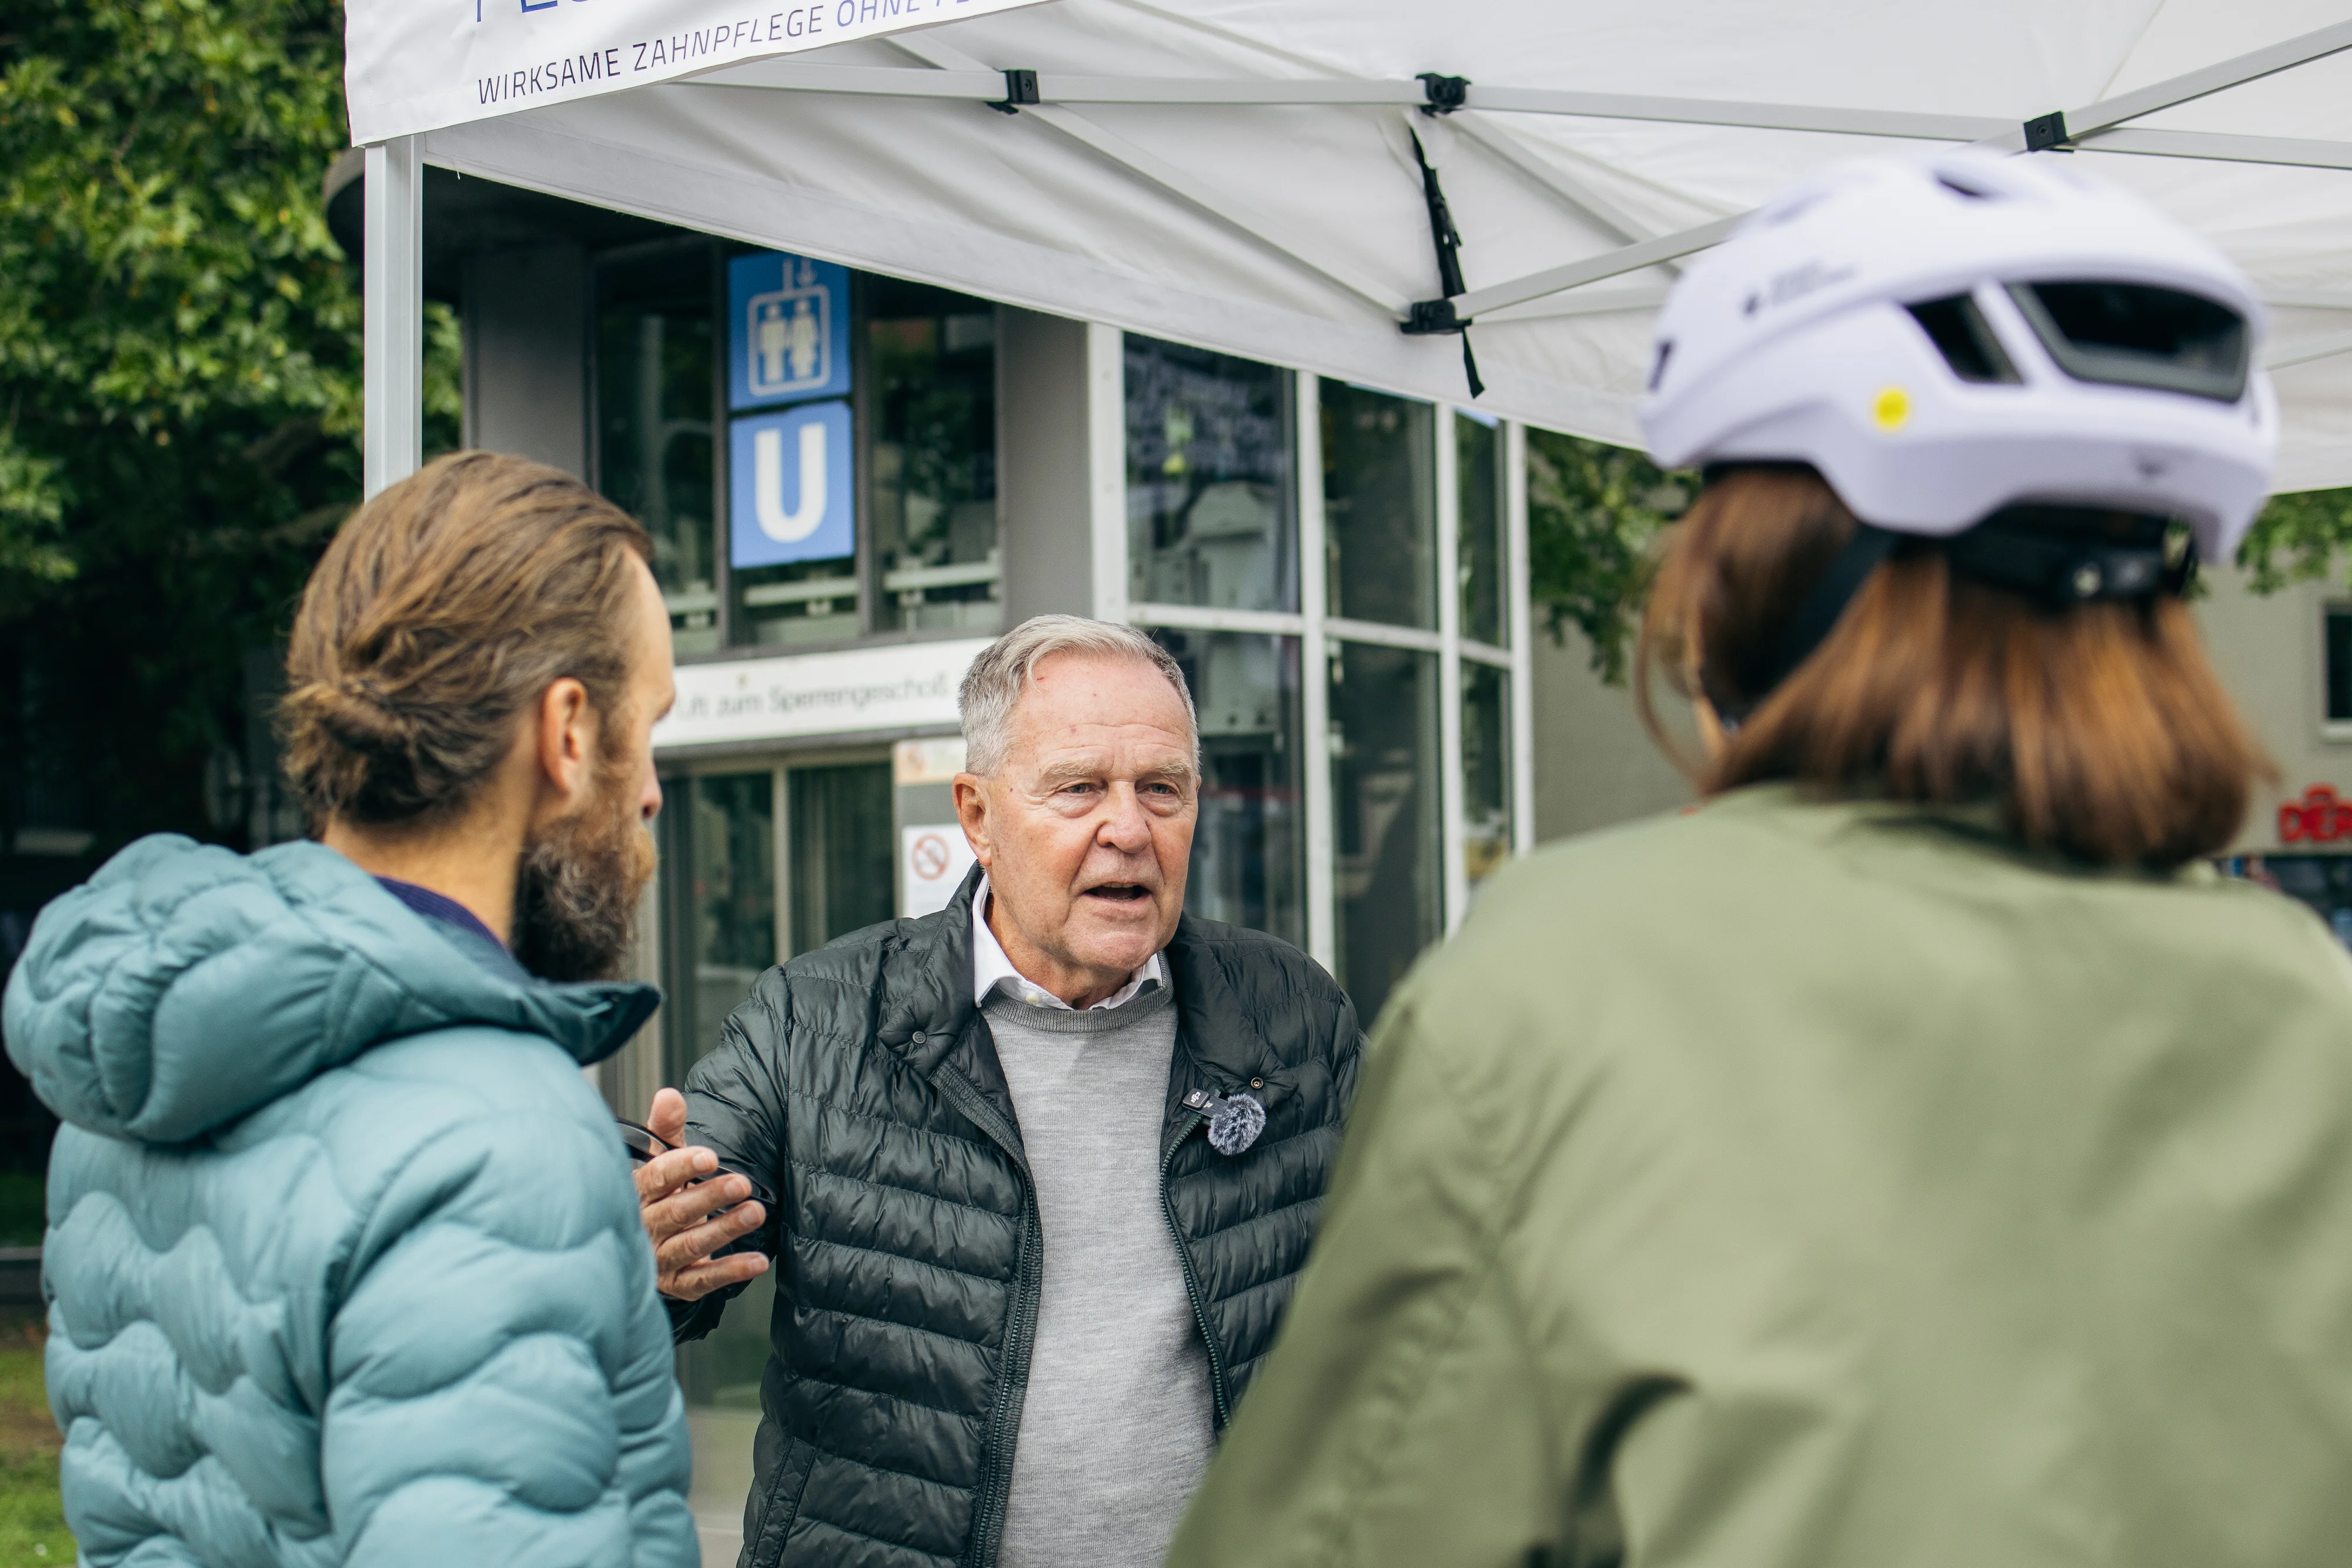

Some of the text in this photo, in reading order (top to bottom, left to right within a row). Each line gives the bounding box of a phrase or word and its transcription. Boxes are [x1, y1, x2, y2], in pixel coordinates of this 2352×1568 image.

[479, 48, 621, 105] WIRKSAME
[633, 5, 823, 72] ZAHNPFLEGE
[755, 423, 827, 543] U
[715, 692, 765, 718] zum
